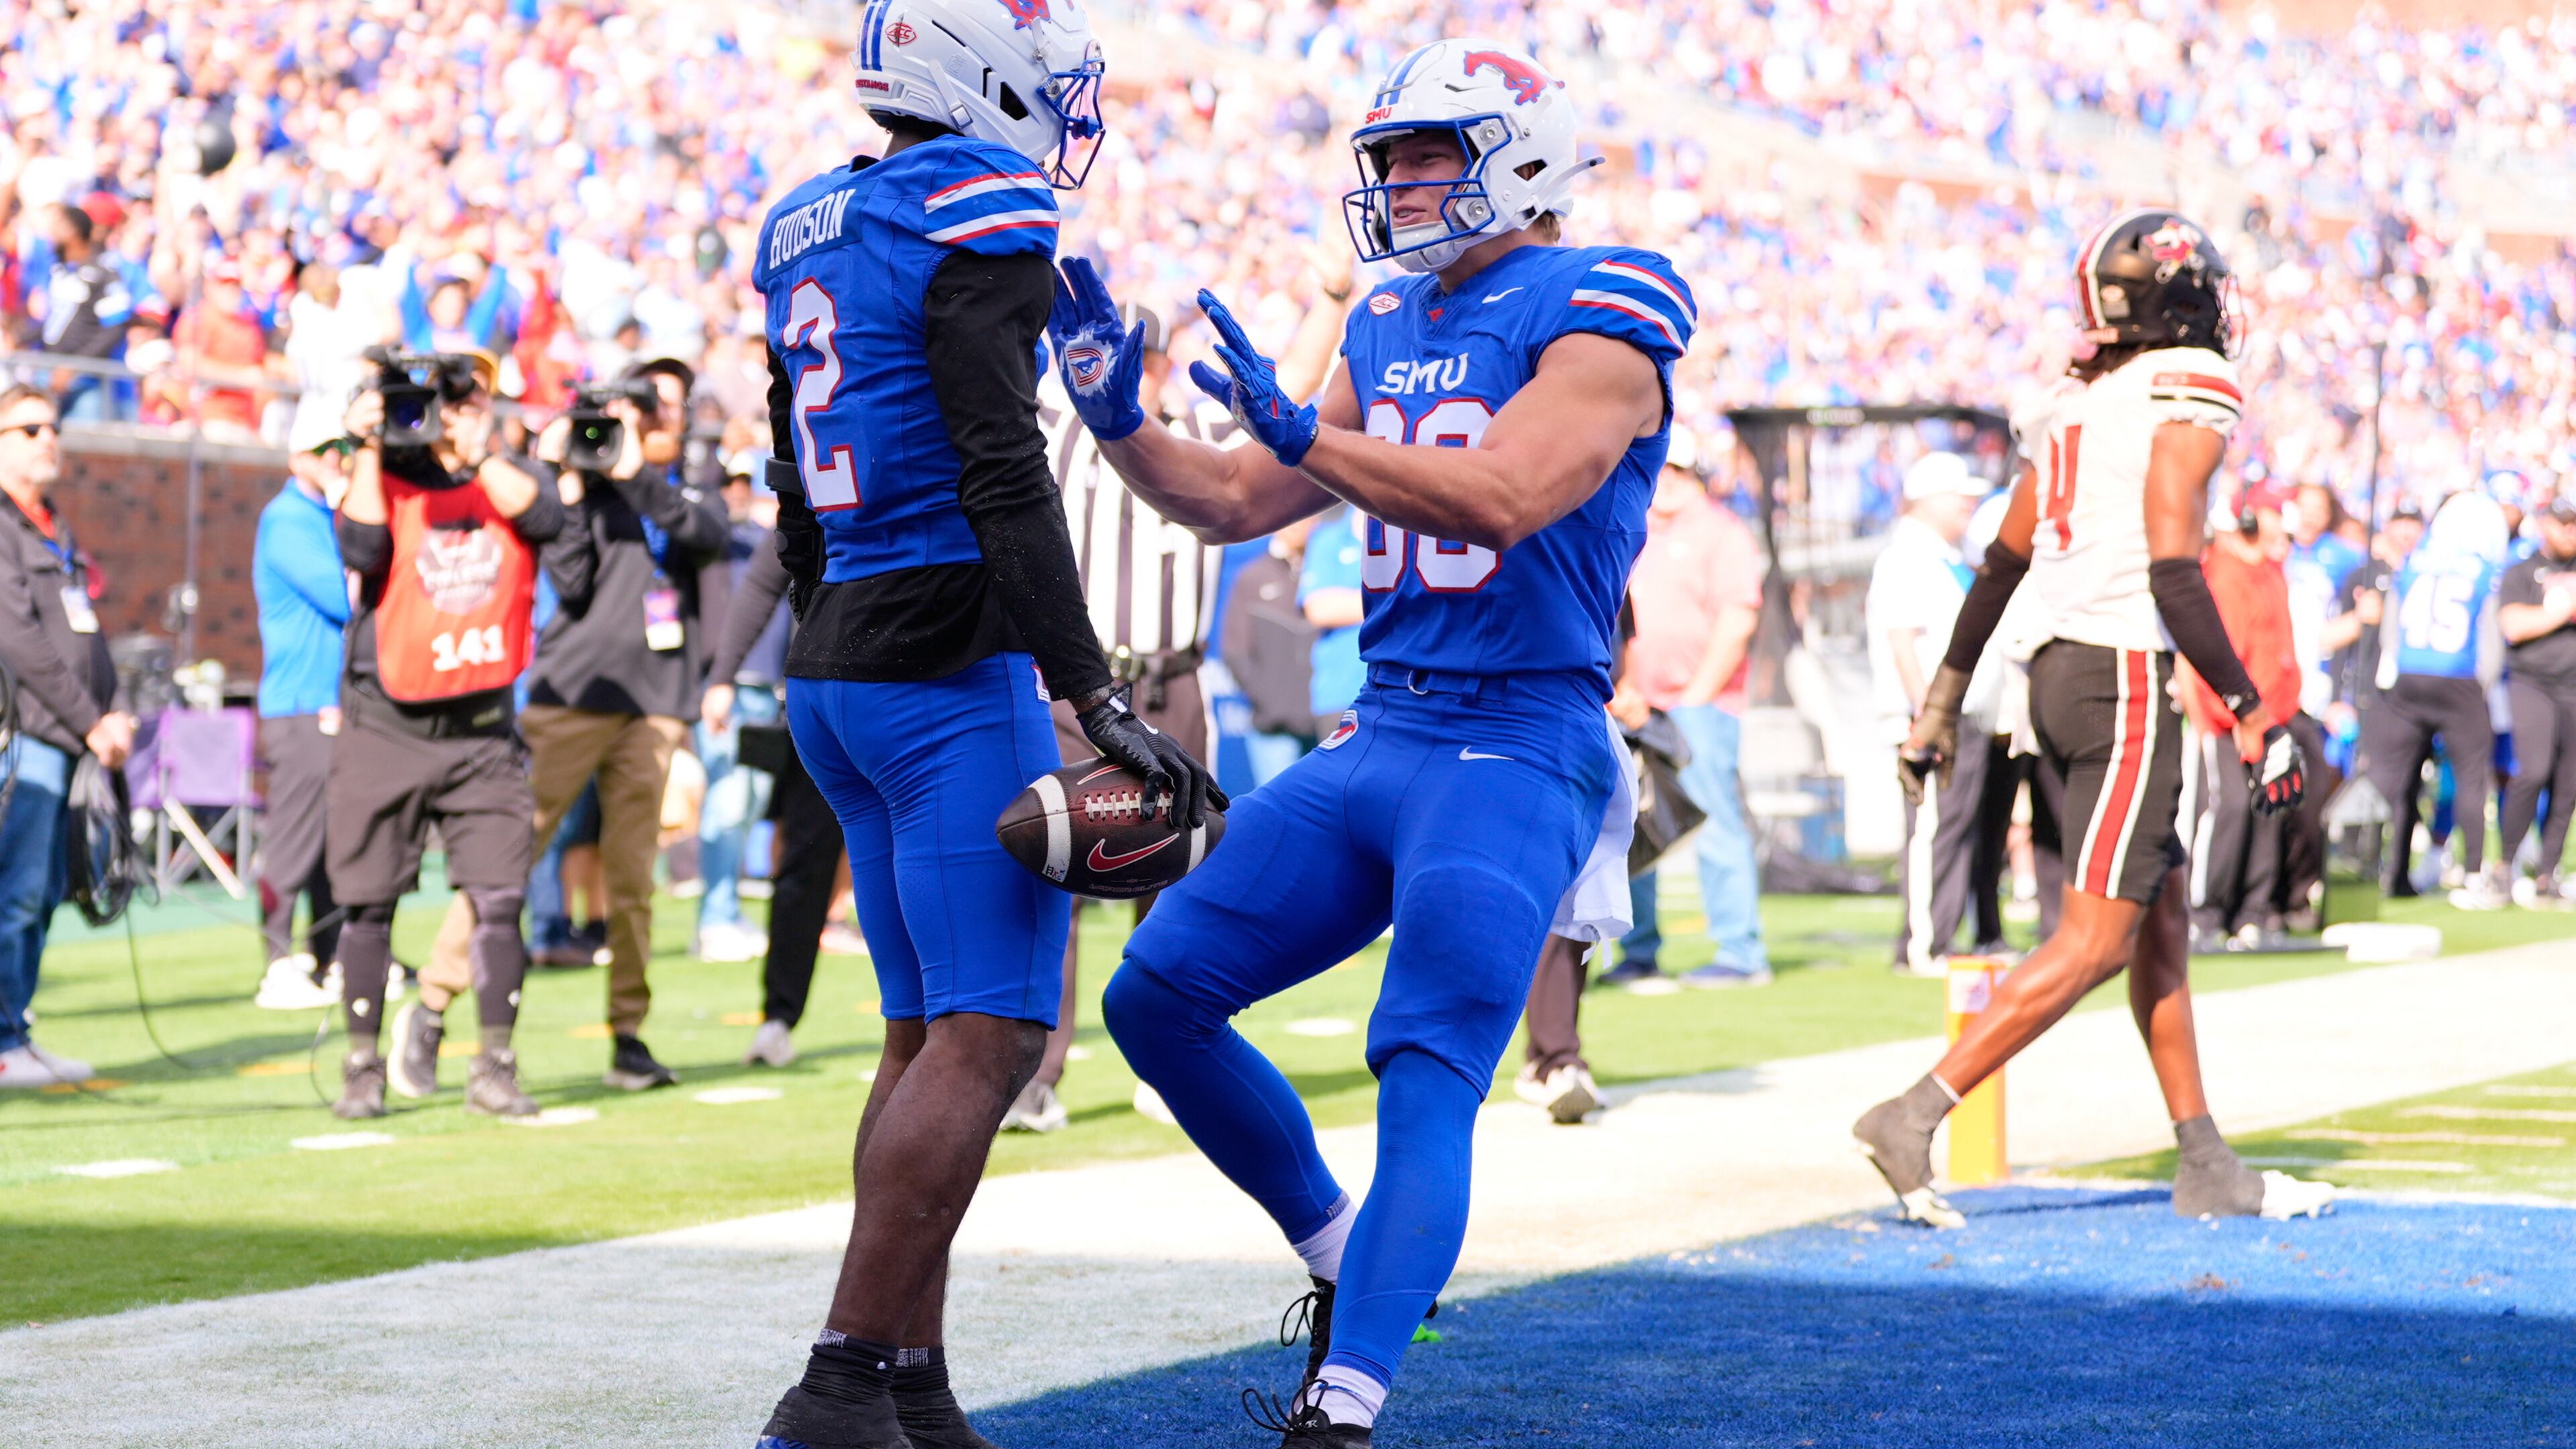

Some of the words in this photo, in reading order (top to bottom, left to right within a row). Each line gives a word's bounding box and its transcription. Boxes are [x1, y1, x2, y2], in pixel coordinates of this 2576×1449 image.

[1365, 107, 1392, 124] SMU
[769, 189, 856, 270] HUDSON
[781, 276, 863, 512] 2
[1375, 352, 1468, 394] SMU
[431, 624, 506, 672] 141
